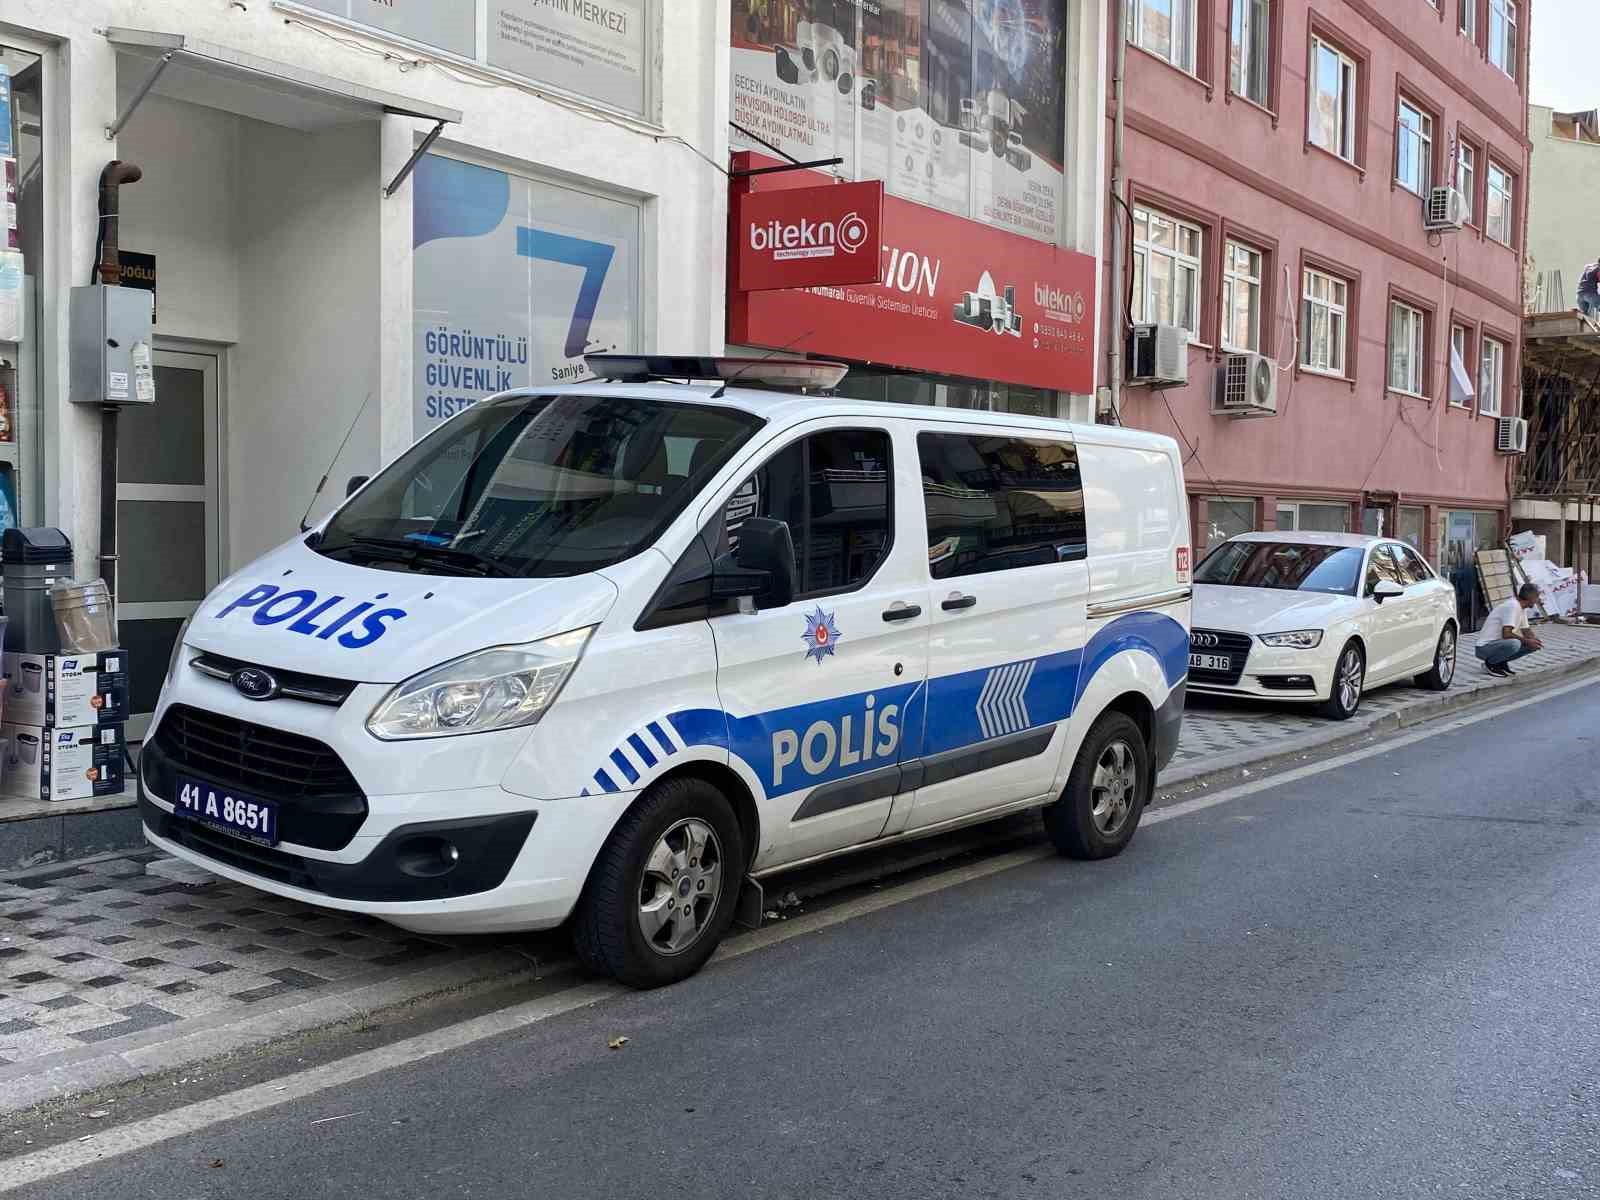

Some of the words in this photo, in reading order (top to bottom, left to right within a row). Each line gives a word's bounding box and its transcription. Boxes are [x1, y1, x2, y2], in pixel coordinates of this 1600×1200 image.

[573, 0, 627, 35] MERKEZİ
[735, 91, 772, 115] HIKVISION
[807, 116, 831, 134] ULTRA
[763, 84, 806, 112] AYDINLATIN
[762, 117, 814, 146] AYDINLATMALI
[881, 245, 941, 297] ION
[516, 225, 616, 359] 7
[846, 288, 875, 307] Güvenlik
[425, 326, 527, 364] GÖRÜNTÜLÜ
[425, 358, 512, 392] GÜVENLİK
[551, 362, 585, 381] Saniye
[213, 583, 408, 649] POLİS
[1208, 656, 1229, 669] 316
[772, 694, 899, 787] POLİS
[180, 783, 199, 811] 41
[205, 791, 219, 818] A
[223, 796, 269, 833] 8651
